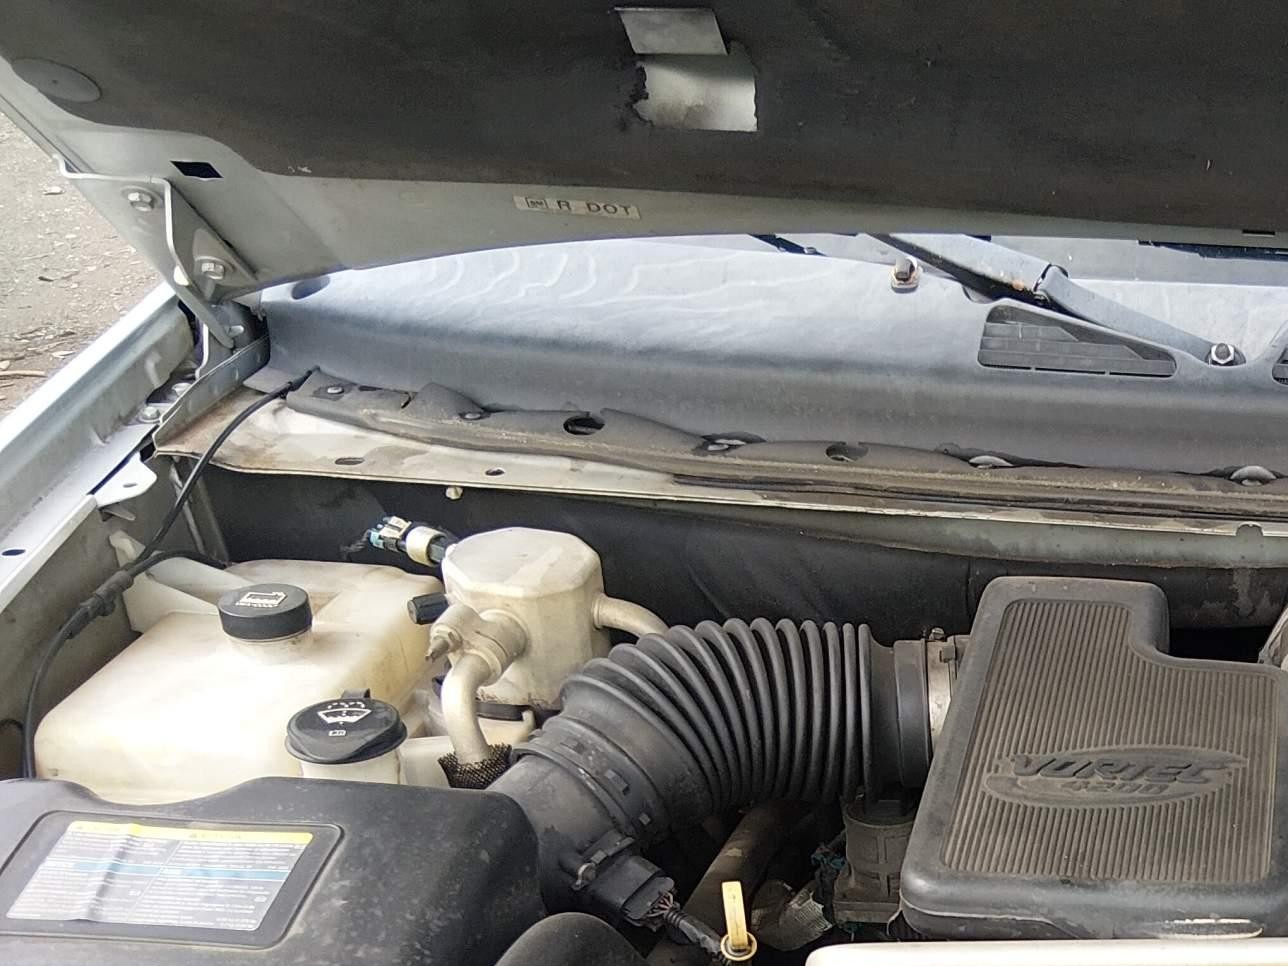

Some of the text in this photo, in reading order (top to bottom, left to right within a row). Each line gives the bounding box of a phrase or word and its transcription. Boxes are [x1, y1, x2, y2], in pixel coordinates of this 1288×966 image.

[585, 202, 631, 215] DOT
[1011, 754, 1232, 785] VORTEC
[1060, 780, 1170, 795] 4200
